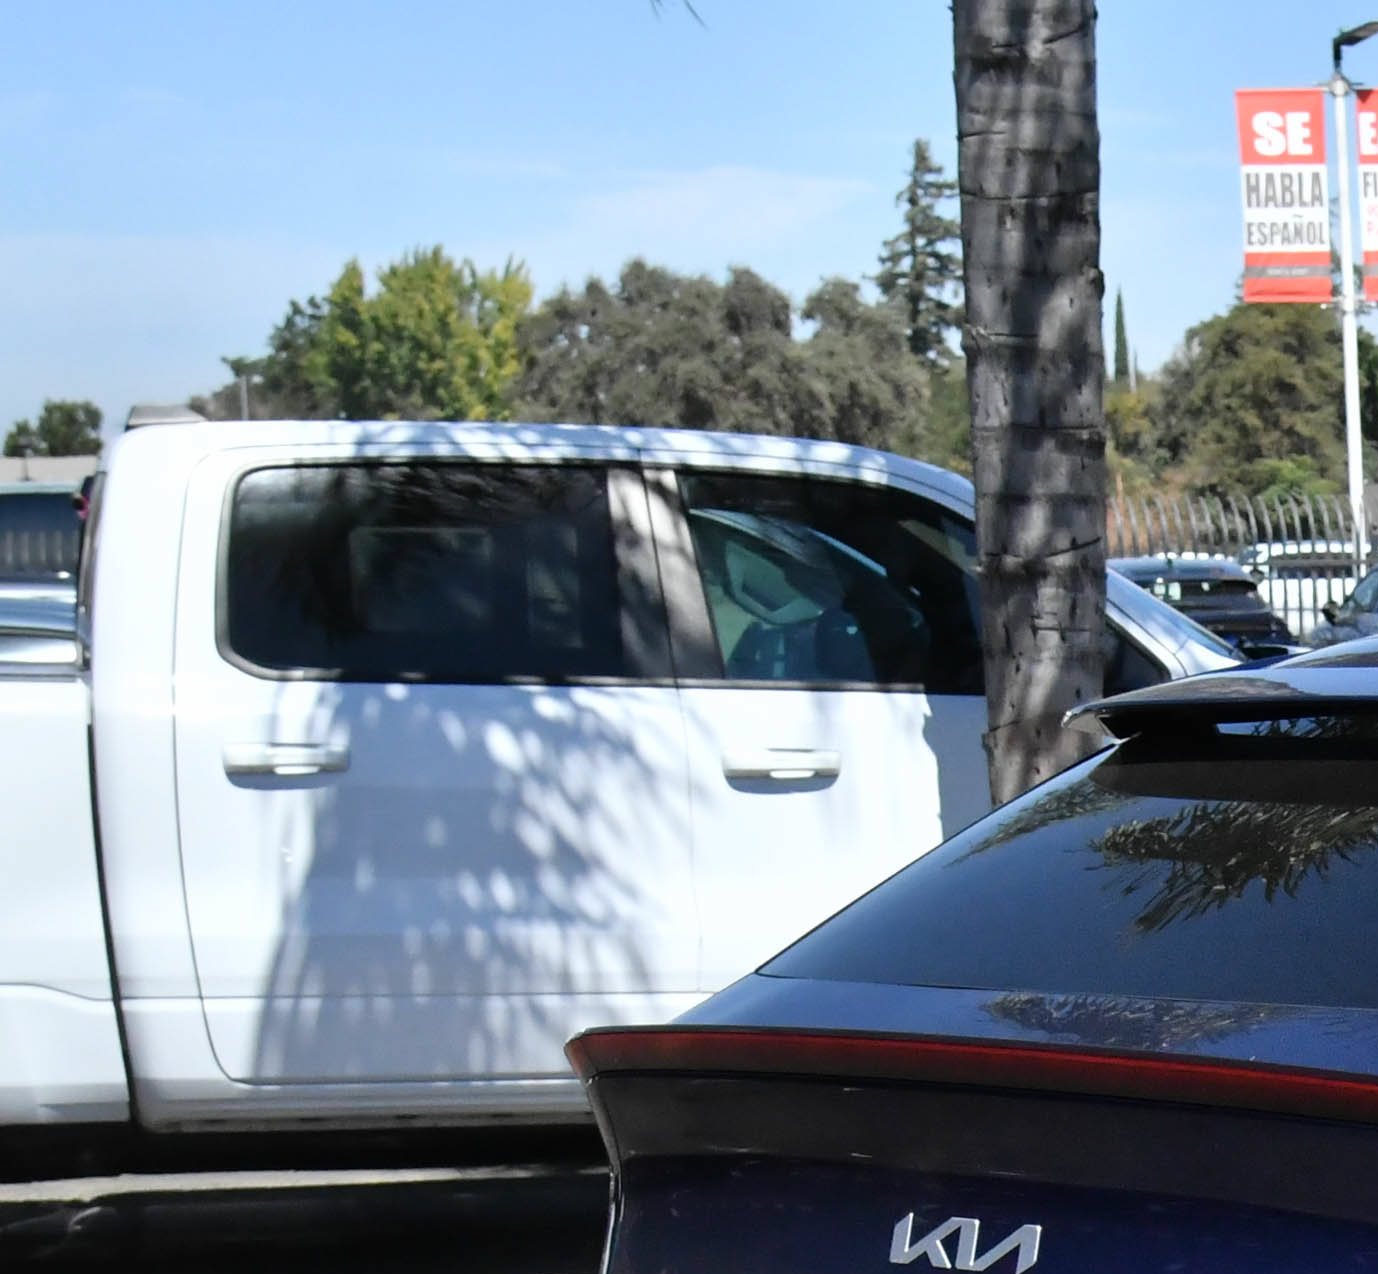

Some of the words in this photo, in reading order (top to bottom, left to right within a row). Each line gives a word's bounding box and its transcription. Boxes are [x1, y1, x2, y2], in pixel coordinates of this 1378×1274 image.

[1252, 111, 1314, 156] SE
[1245, 171, 1324, 208] HABLA
[1246, 213, 1325, 246] ESPAÑOL
